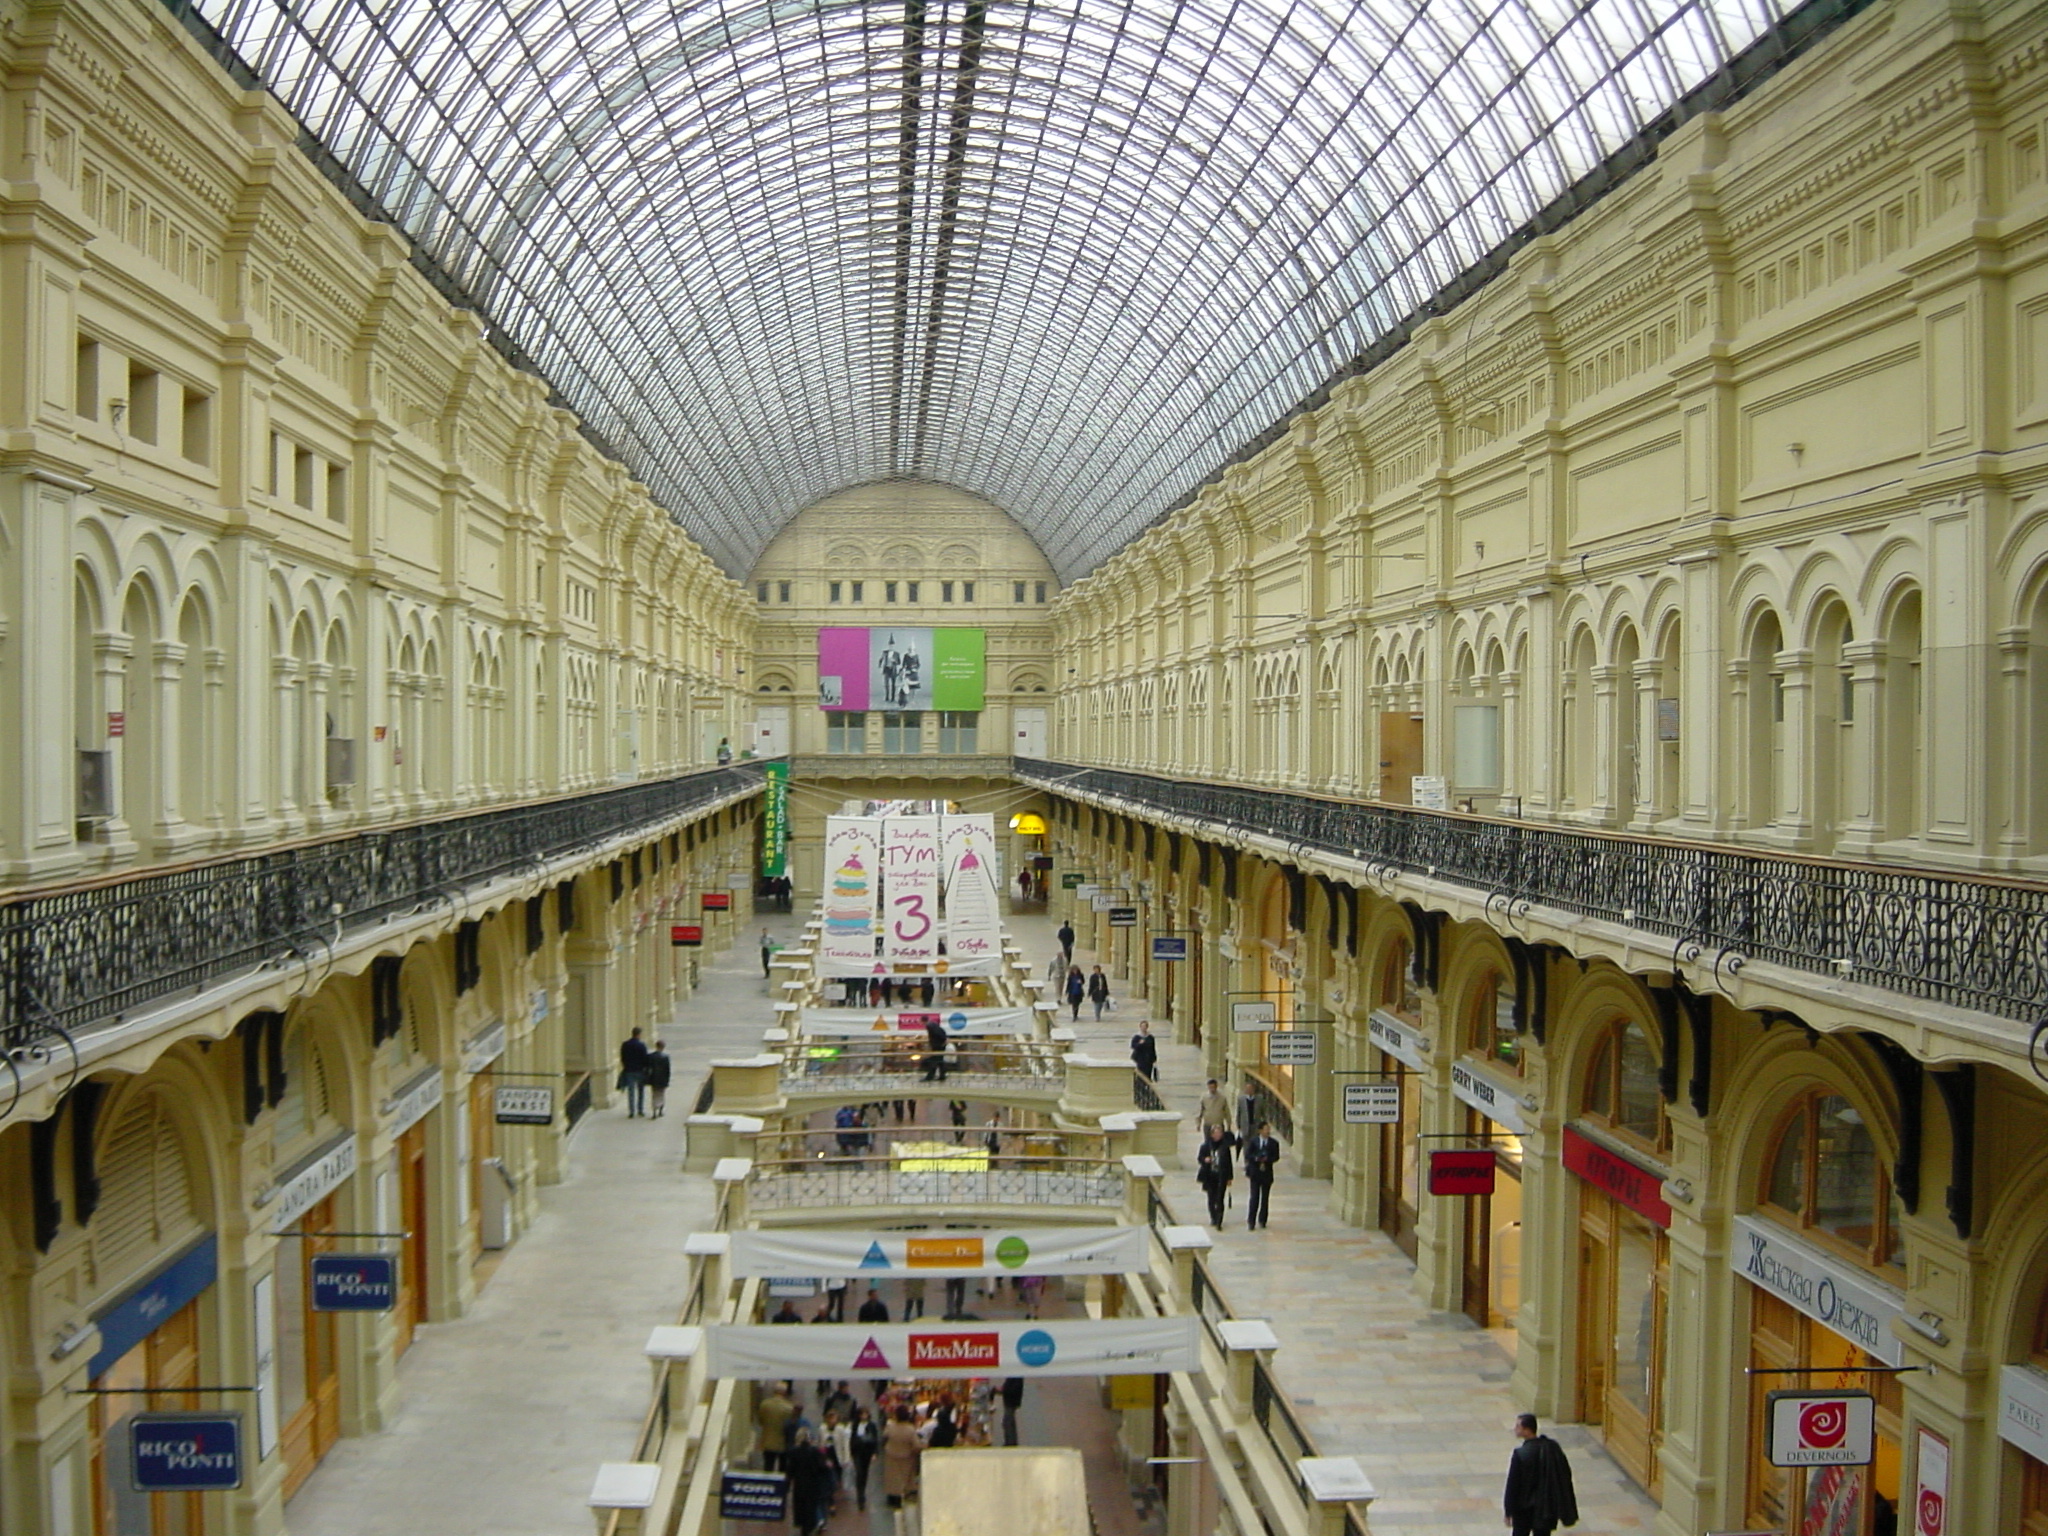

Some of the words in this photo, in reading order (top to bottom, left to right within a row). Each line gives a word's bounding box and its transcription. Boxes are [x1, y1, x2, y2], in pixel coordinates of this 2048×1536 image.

[765, 770, 776, 869] RESTAURANT
[894, 894, 931, 942] 3
[1369, 1017, 1384, 1037] GERRY
[1384, 1026, 1401, 1050] WEBER
[1452, 1065, 1472, 1092] GERRY
[1472, 1076, 1496, 1107] WEBER
[501, 1101, 546, 1110] PABST
[322, 1144, 355, 1187] PABST
[316, 1272, 362, 1287] RICO
[338, 1284, 389, 1297] PONTI
[1746, 1231, 1813, 1306] Женская
[1818, 1276, 1879, 1347] Одежда
[915, 1339, 994, 1360] MaxMara
[2008, 1402, 2041, 1431] PARIS
[138, 1440, 198, 1458] RICO
[1786, 1449, 1856, 1463] DEVERNOIS
[166, 1453, 234, 1471] PONTI
